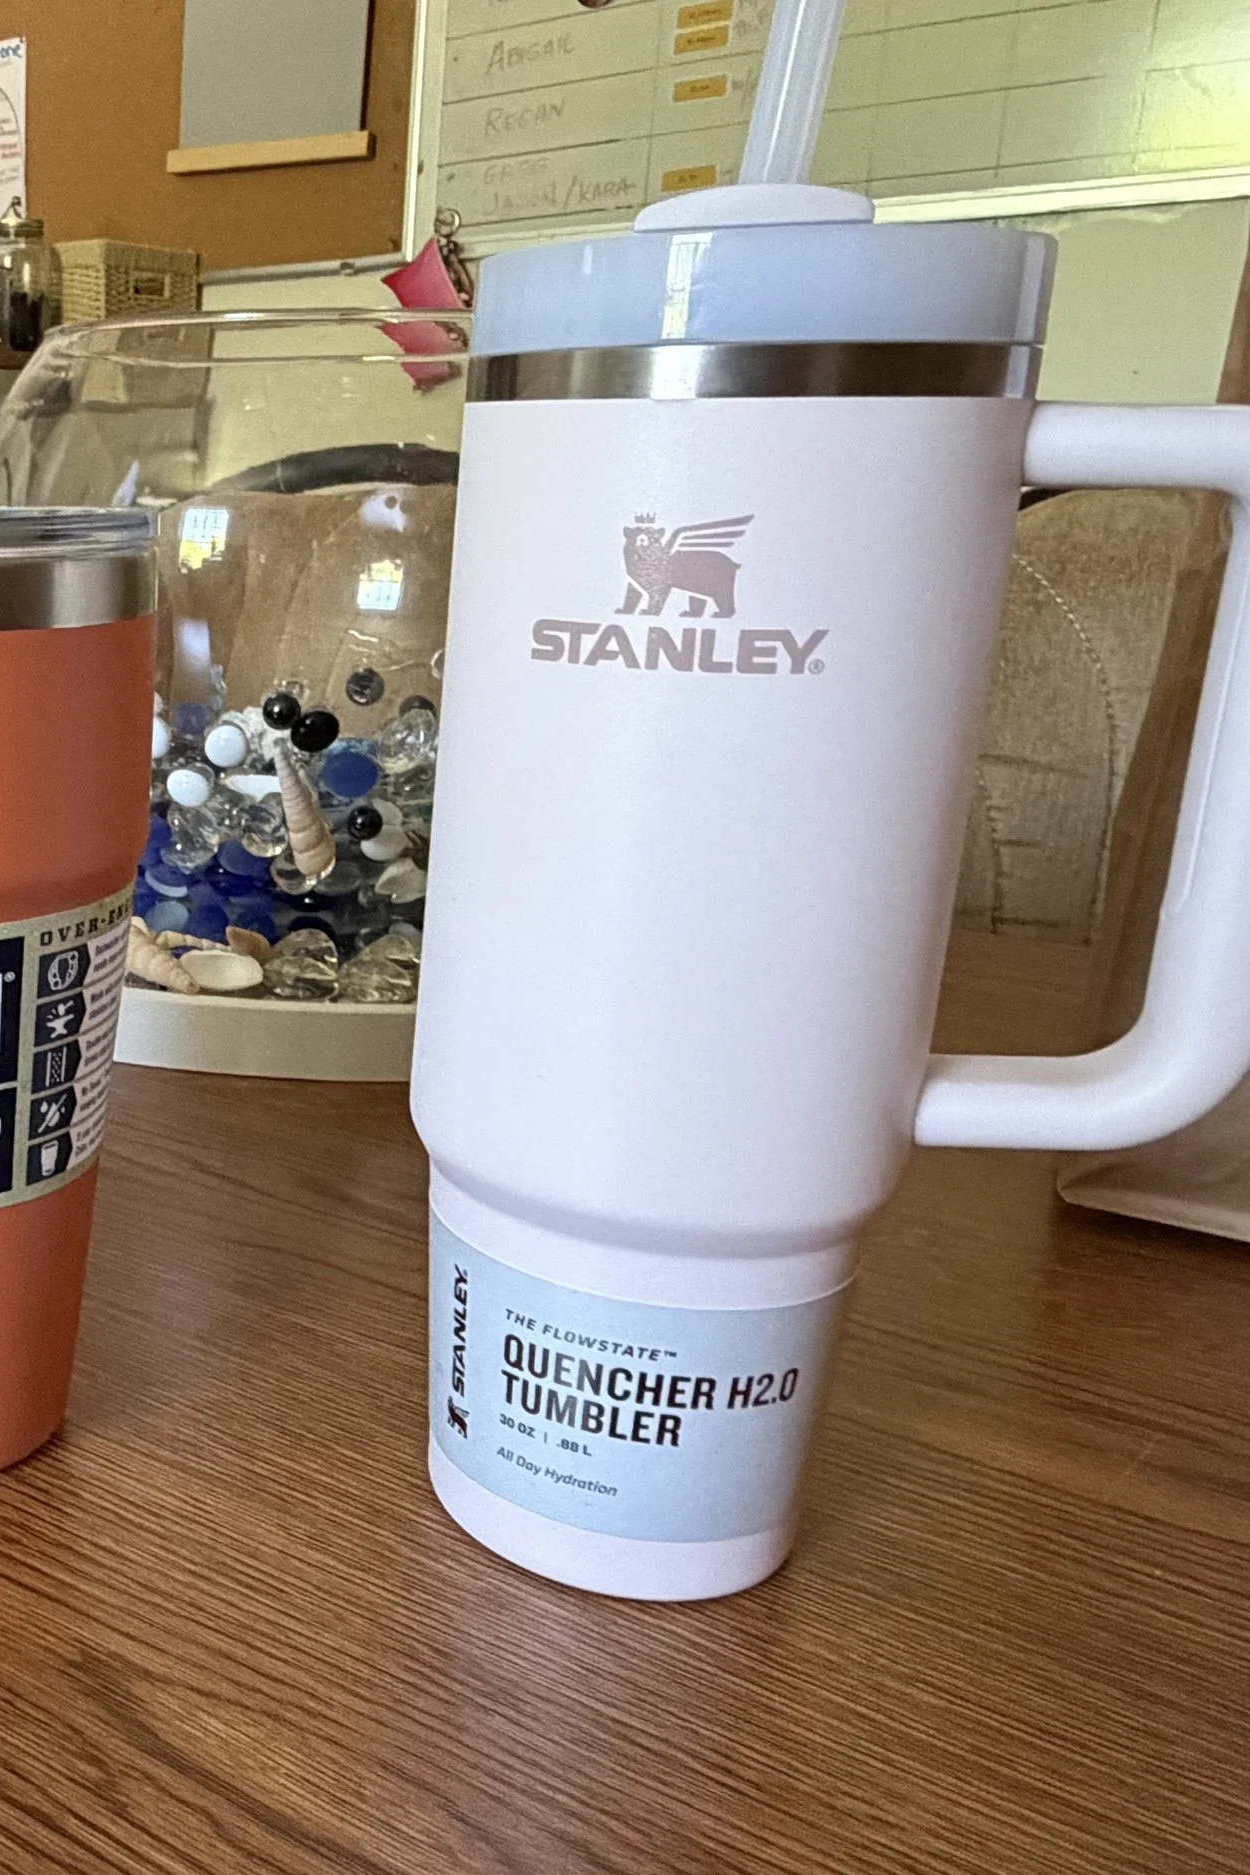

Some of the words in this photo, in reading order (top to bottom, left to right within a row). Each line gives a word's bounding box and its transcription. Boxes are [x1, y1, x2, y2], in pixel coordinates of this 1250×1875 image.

[505, 1309, 536, 1331] THE
[504, 1334, 716, 1410] QUENCHER
[727, 1368, 799, 1409] H2.0
[501, 1369, 682, 1447] TUMBLER
[499, 1413, 515, 1429] 30
[517, 1422, 536, 1439] OZ
[582, 1444, 592, 1457] L
[496, 1446, 514, 1462] All
[516, 1455, 542, 1476] Day
[544, 1466, 618, 1497] Hydration
